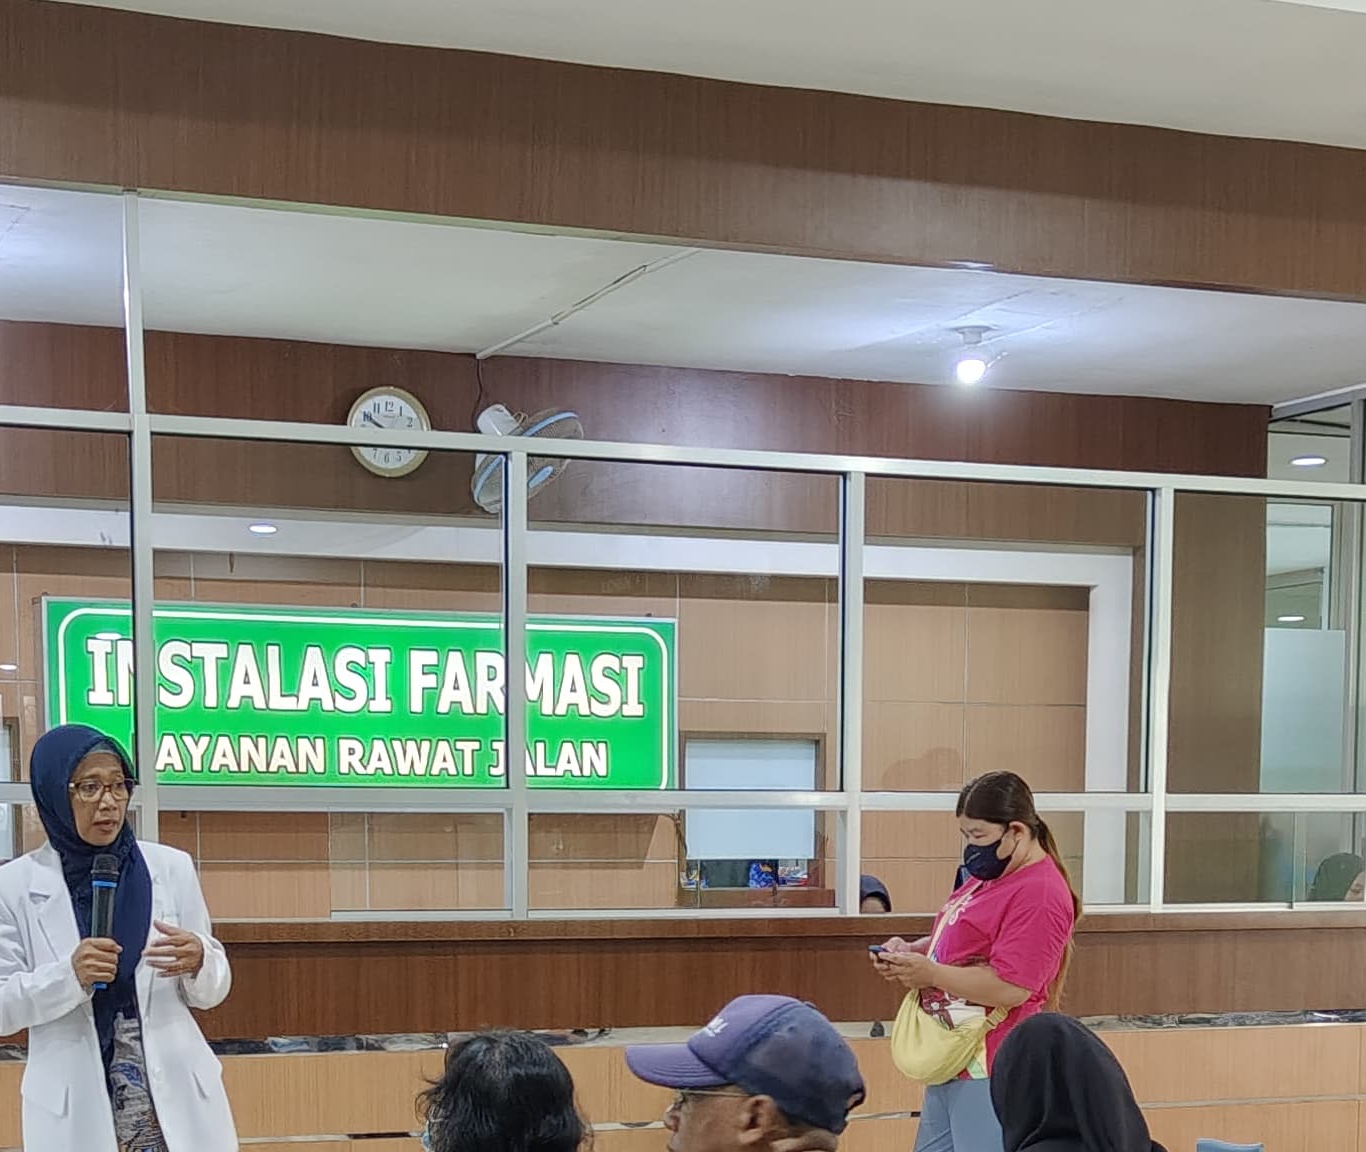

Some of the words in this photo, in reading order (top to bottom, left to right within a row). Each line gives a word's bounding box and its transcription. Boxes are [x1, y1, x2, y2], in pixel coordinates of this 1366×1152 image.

[373, 402, 380, 414] 11
[385, 401, 394, 412] 12
[406, 417, 413, 428] 2
[409, 648, 645, 718] FARMASI
[154, 733, 326, 775] AYANAN
[337, 736, 481, 777] RAWAT
